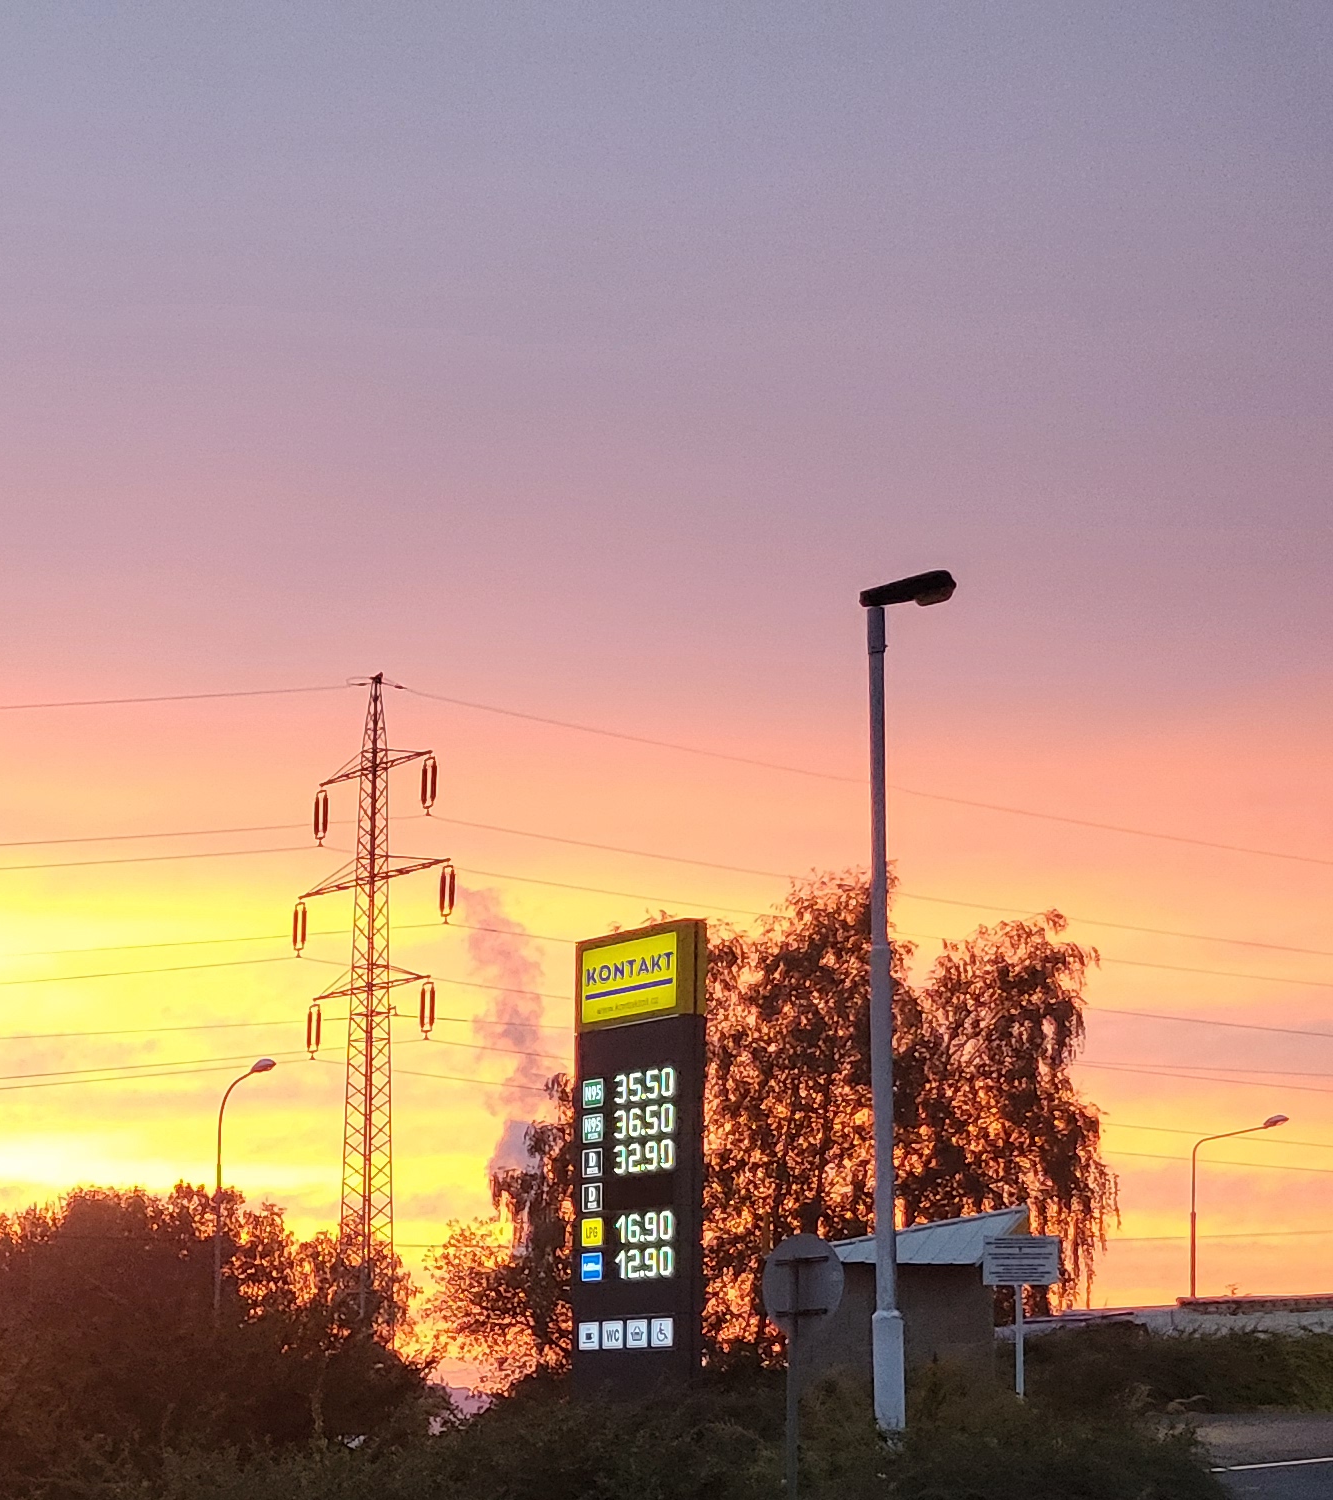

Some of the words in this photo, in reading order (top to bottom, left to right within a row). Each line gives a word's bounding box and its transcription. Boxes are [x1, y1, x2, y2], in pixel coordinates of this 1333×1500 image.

[585, 951, 674, 987] KONTAKT
[584, 1084, 602, 1101] N95
[613, 1067, 675, 1104] 35.50
[584, 1117, 602, 1134] N95
[613, 1103, 675, 1140] 36.50
[588, 1152, 597, 1167] D
[613, 1139, 675, 1175] 32.90
[588, 1187, 596, 1202] D
[585, 1226, 598, 1240] LPG
[615, 1211, 675, 1244] 16.90
[615, 1246, 674, 1280] 12.90
[606, 1328, 620, 1343] WC
